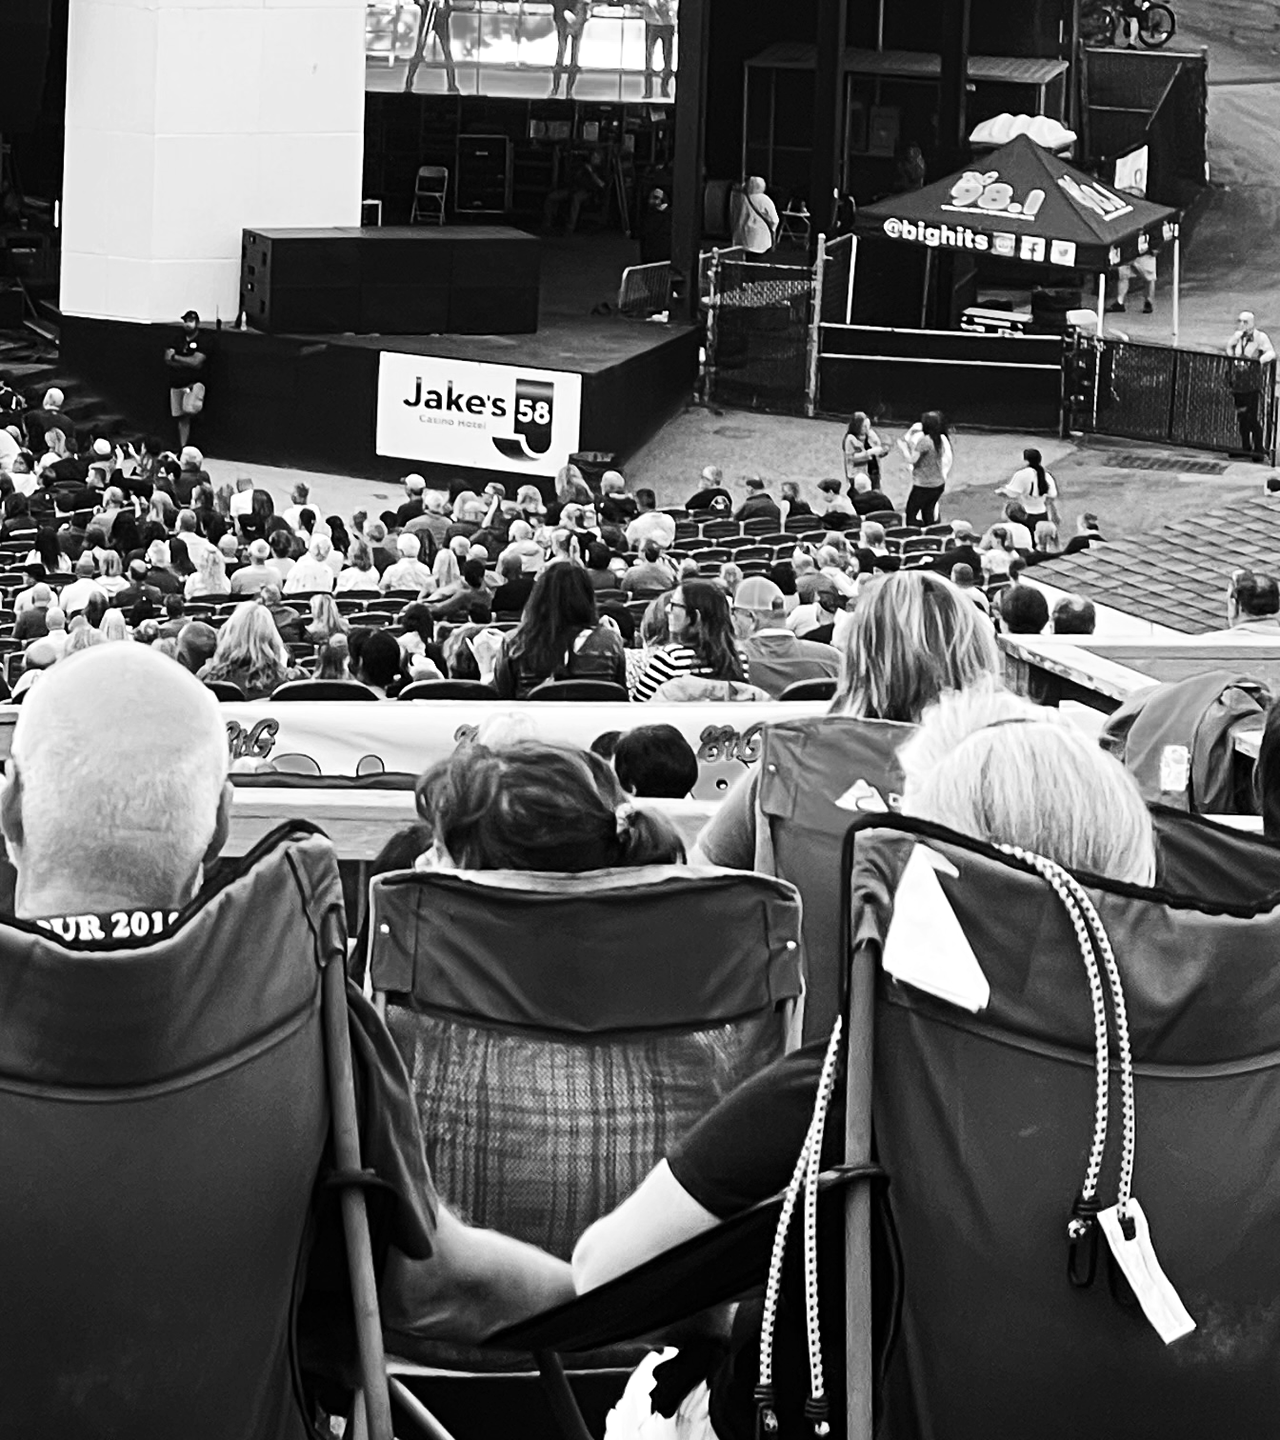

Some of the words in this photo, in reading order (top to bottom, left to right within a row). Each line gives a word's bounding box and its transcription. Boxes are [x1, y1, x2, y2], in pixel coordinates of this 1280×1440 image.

[883, 217, 989, 251] @bighits
[402, 376, 507, 418] Jake's
[516, 398, 551, 425] 58
[418, 414, 455, 426] Casino
[457, 419, 487, 430] Hotel
